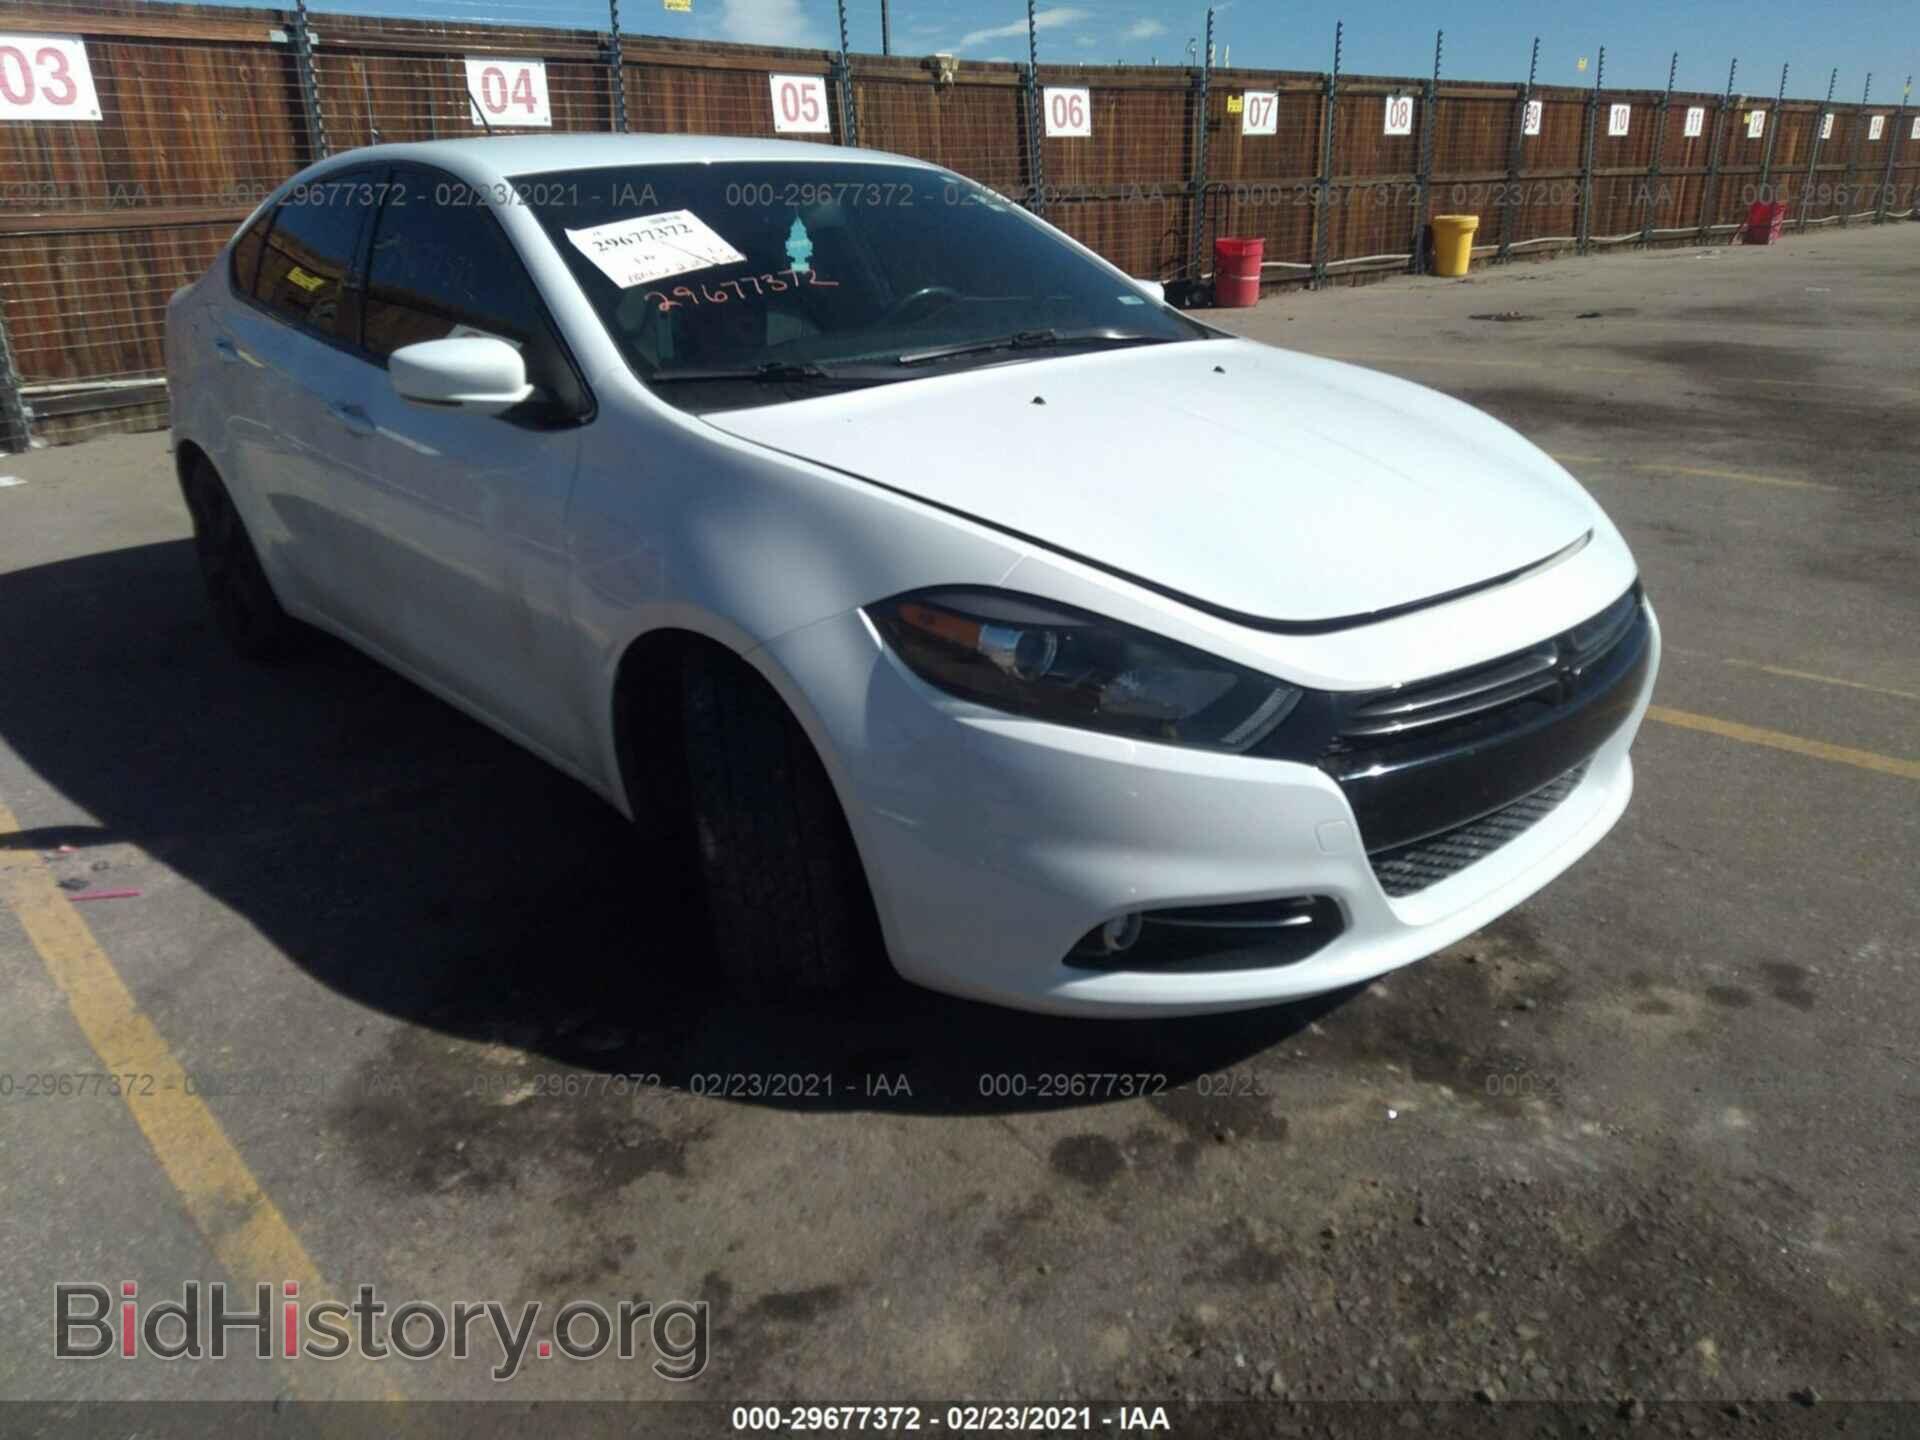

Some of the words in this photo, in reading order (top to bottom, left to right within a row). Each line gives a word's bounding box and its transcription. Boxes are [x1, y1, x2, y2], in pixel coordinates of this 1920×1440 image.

[0, 45, 78, 106] 03
[481, 66, 537, 115] 04
[780, 81, 820, 123] 05
[1051, 94, 1084, 129] 06
[1249, 96, 1273, 127] 07
[1390, 101, 1409, 128] 08
[1614, 107, 1629, 131] 10
[1690, 111, 1702, 132] 11
[592, 223, 693, 252] 29677372
[644, 270, 839, 312] 29677372
